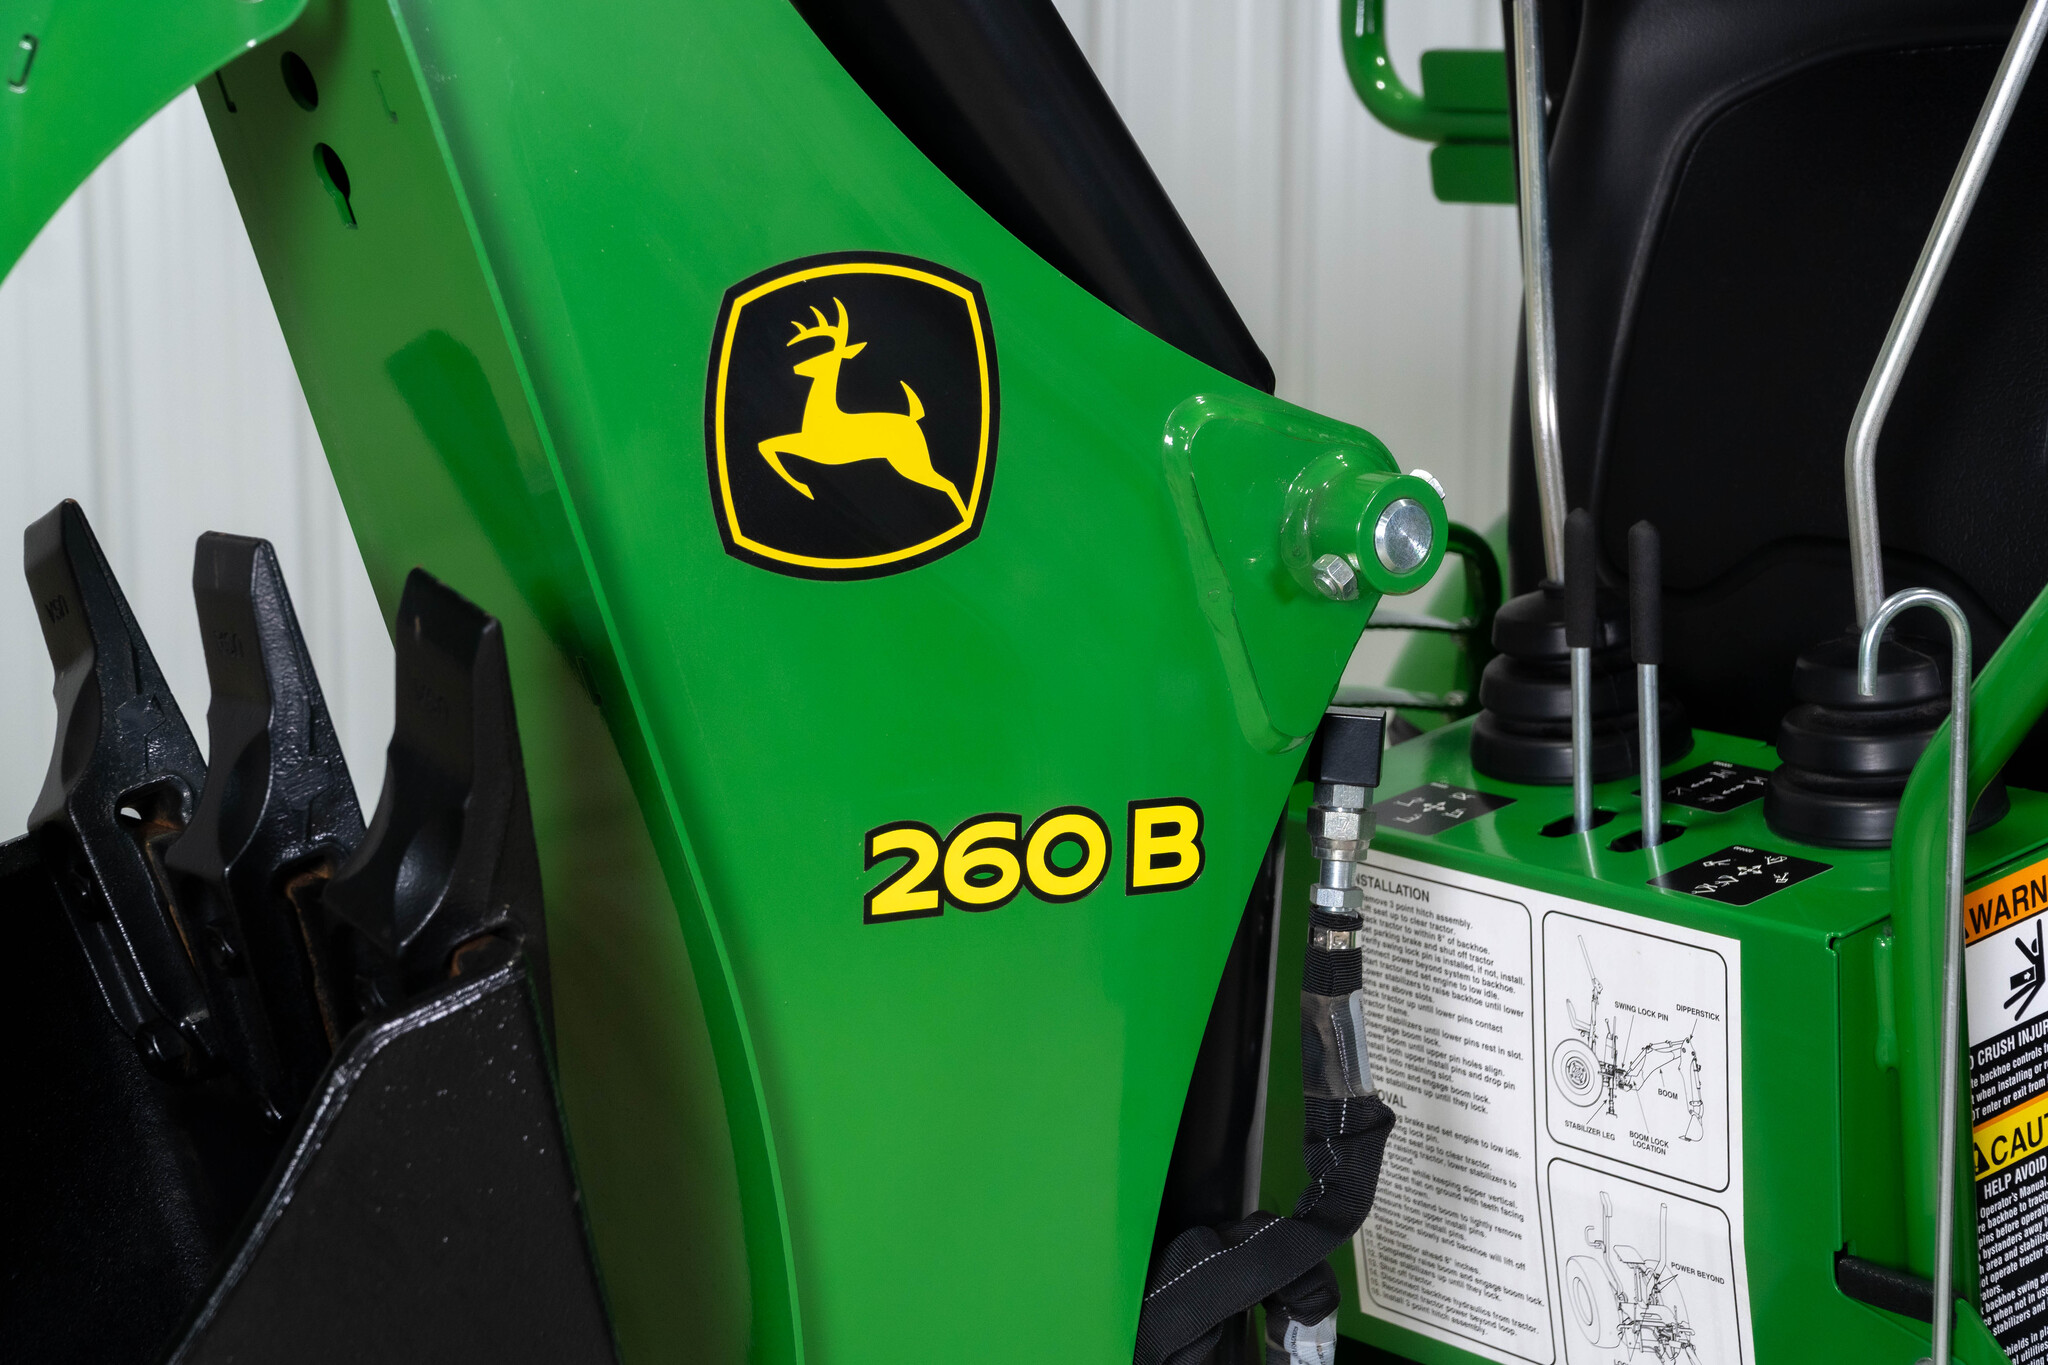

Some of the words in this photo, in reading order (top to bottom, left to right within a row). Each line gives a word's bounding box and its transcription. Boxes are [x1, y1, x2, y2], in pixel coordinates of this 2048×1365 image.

[863, 804, 1112, 925] 260
[1125, 797, 1206, 896] B
[1415, 906, 1434, 918] hitch
[1969, 875, 2047, 936] WARN
[1413, 926, 1435, 939] within
[1447, 935, 1454, 944] of
[1456, 938, 1489, 954] backhoe.
[1423, 940, 1437, 950] and
[1439, 944, 1455, 955] shut
[1457, 948, 1467, 958] off
[1469, 952, 1493, 966] tractor
[1415, 958, 1442, 974] beyond
[1444, 966, 1470, 982] system
[1472, 974, 1479, 983] to
[1481, 976, 1515, 993] backhoe.
[1421, 949, 1432, 961] pin
[1442, 955, 1473, 972] installed,
[1477, 964, 1482, 973] if
[1484, 966, 1498, 979] not,
[1500, 970, 1524, 984] install.
[1420, 970, 1431, 980] set
[1432, 974, 1457, 989] engine
[1459, 981, 1466, 990] to
[1468, 983, 1481, 994] low
[1483, 988, 1499, 999] idle.
[1422, 981, 1430, 990] to
[1432, 984, 1449, 996] raise
[1451, 989, 1482, 1005] backhoe
[1484, 998, 1501, 1010] until
[1503, 1004, 1523, 1016] lower
[1457, 1012, 1472, 1025] pins
[1475, 1017, 1502, 1032] contact
[1614, 1001, 1636, 1013] SWING
[1638, 1007, 1656, 1018] LOCK
[1658, 1012, 1669, 1022] PIN
[1676, 1004, 1720, 1021] DIPPERSTICK
[1441, 1029, 1461, 1042] lower
[1463, 1035, 1479, 1048] pins
[1481, 1040, 1496, 1052] rest
[1497, 1045, 1505, 1054] in
[1507, 1047, 1523, 1059] slot.
[1978, 1035, 2015, 1065] CRUSH
[1448, 1052, 1460, 1064] pin
[1462, 1056, 1482, 1069] holes
[1484, 1062, 1504, 1077] align.
[1450, 1063, 1466, 1077] pins
[1468, 1068, 1482, 1080] and
[1484, 1073, 1501, 1087] drop
[1503, 1078, 1515, 1091] pin
[1980, 1063, 2010, 1083] backhoe
[2013, 1047, 2042, 1068] controls
[1658, 1088, 1678, 1100] BOOM
[1976, 1086, 1996, 1101] when
[1998, 1068, 2032, 1091] installing
[2034, 1064, 2042, 1074] or
[1982, 1100, 2001, 1115] enter
[2004, 1095, 2011, 1105] or
[2013, 1086, 2027, 1100] exit
[2028, 1078, 2045, 1093] from
[1452, 1095, 1468, 1109] they
[1470, 1100, 1488, 1113] lock.
[1472, 1091, 1490, 1103] lock.
[1564, 1120, 1600, 1136] STABILIZER
[1602, 1131, 1616, 1140] LEG
[1629, 1130, 1650, 1142] BOOM
[1650, 1137, 1670, 1148] LOCK
[1632, 1140, 1667, 1156] LOCATION
[1984, 1173, 2011, 1199] HELP
[2015, 1156, 2047, 1184] AVOID
[1981, 1193, 2018, 1218] Operator's
[1987, 1207, 2017, 1228] backhoe
[2019, 1202, 2027, 1212] to
[1979, 1233, 1994, 1249] pins
[1996, 1220, 2019, 1238] before
[1983, 1232, 2022, 1259] bystanders
[2024, 1222, 2042, 1237] away
[1986, 1257, 2002, 1271] area
[2005, 1246, 2018, 1261] and
[1990, 1262, 2017, 1283] operate
[2019, 1249, 2043, 1267] tractor
[1670, 1261, 1696, 1276] POWER
[1696, 1270, 1725, 1285] BEYOND
[1981, 1285, 2003, 1300] ators.
[1986, 1291, 2015, 1312] backhoe
[2017, 1278, 2038, 1296] swing
[1994, 1306, 2013, 1321] when
[2015, 1297, 2026, 1311] not
[2028, 1288, 2036, 1303] in
[1993, 1307, 2030, 1336] stabilizers
[2032, 1295, 2045, 1315] and
[2021, 1341, 2048, 1362] utilities
[2031, 1333, 2038, 1343] in
